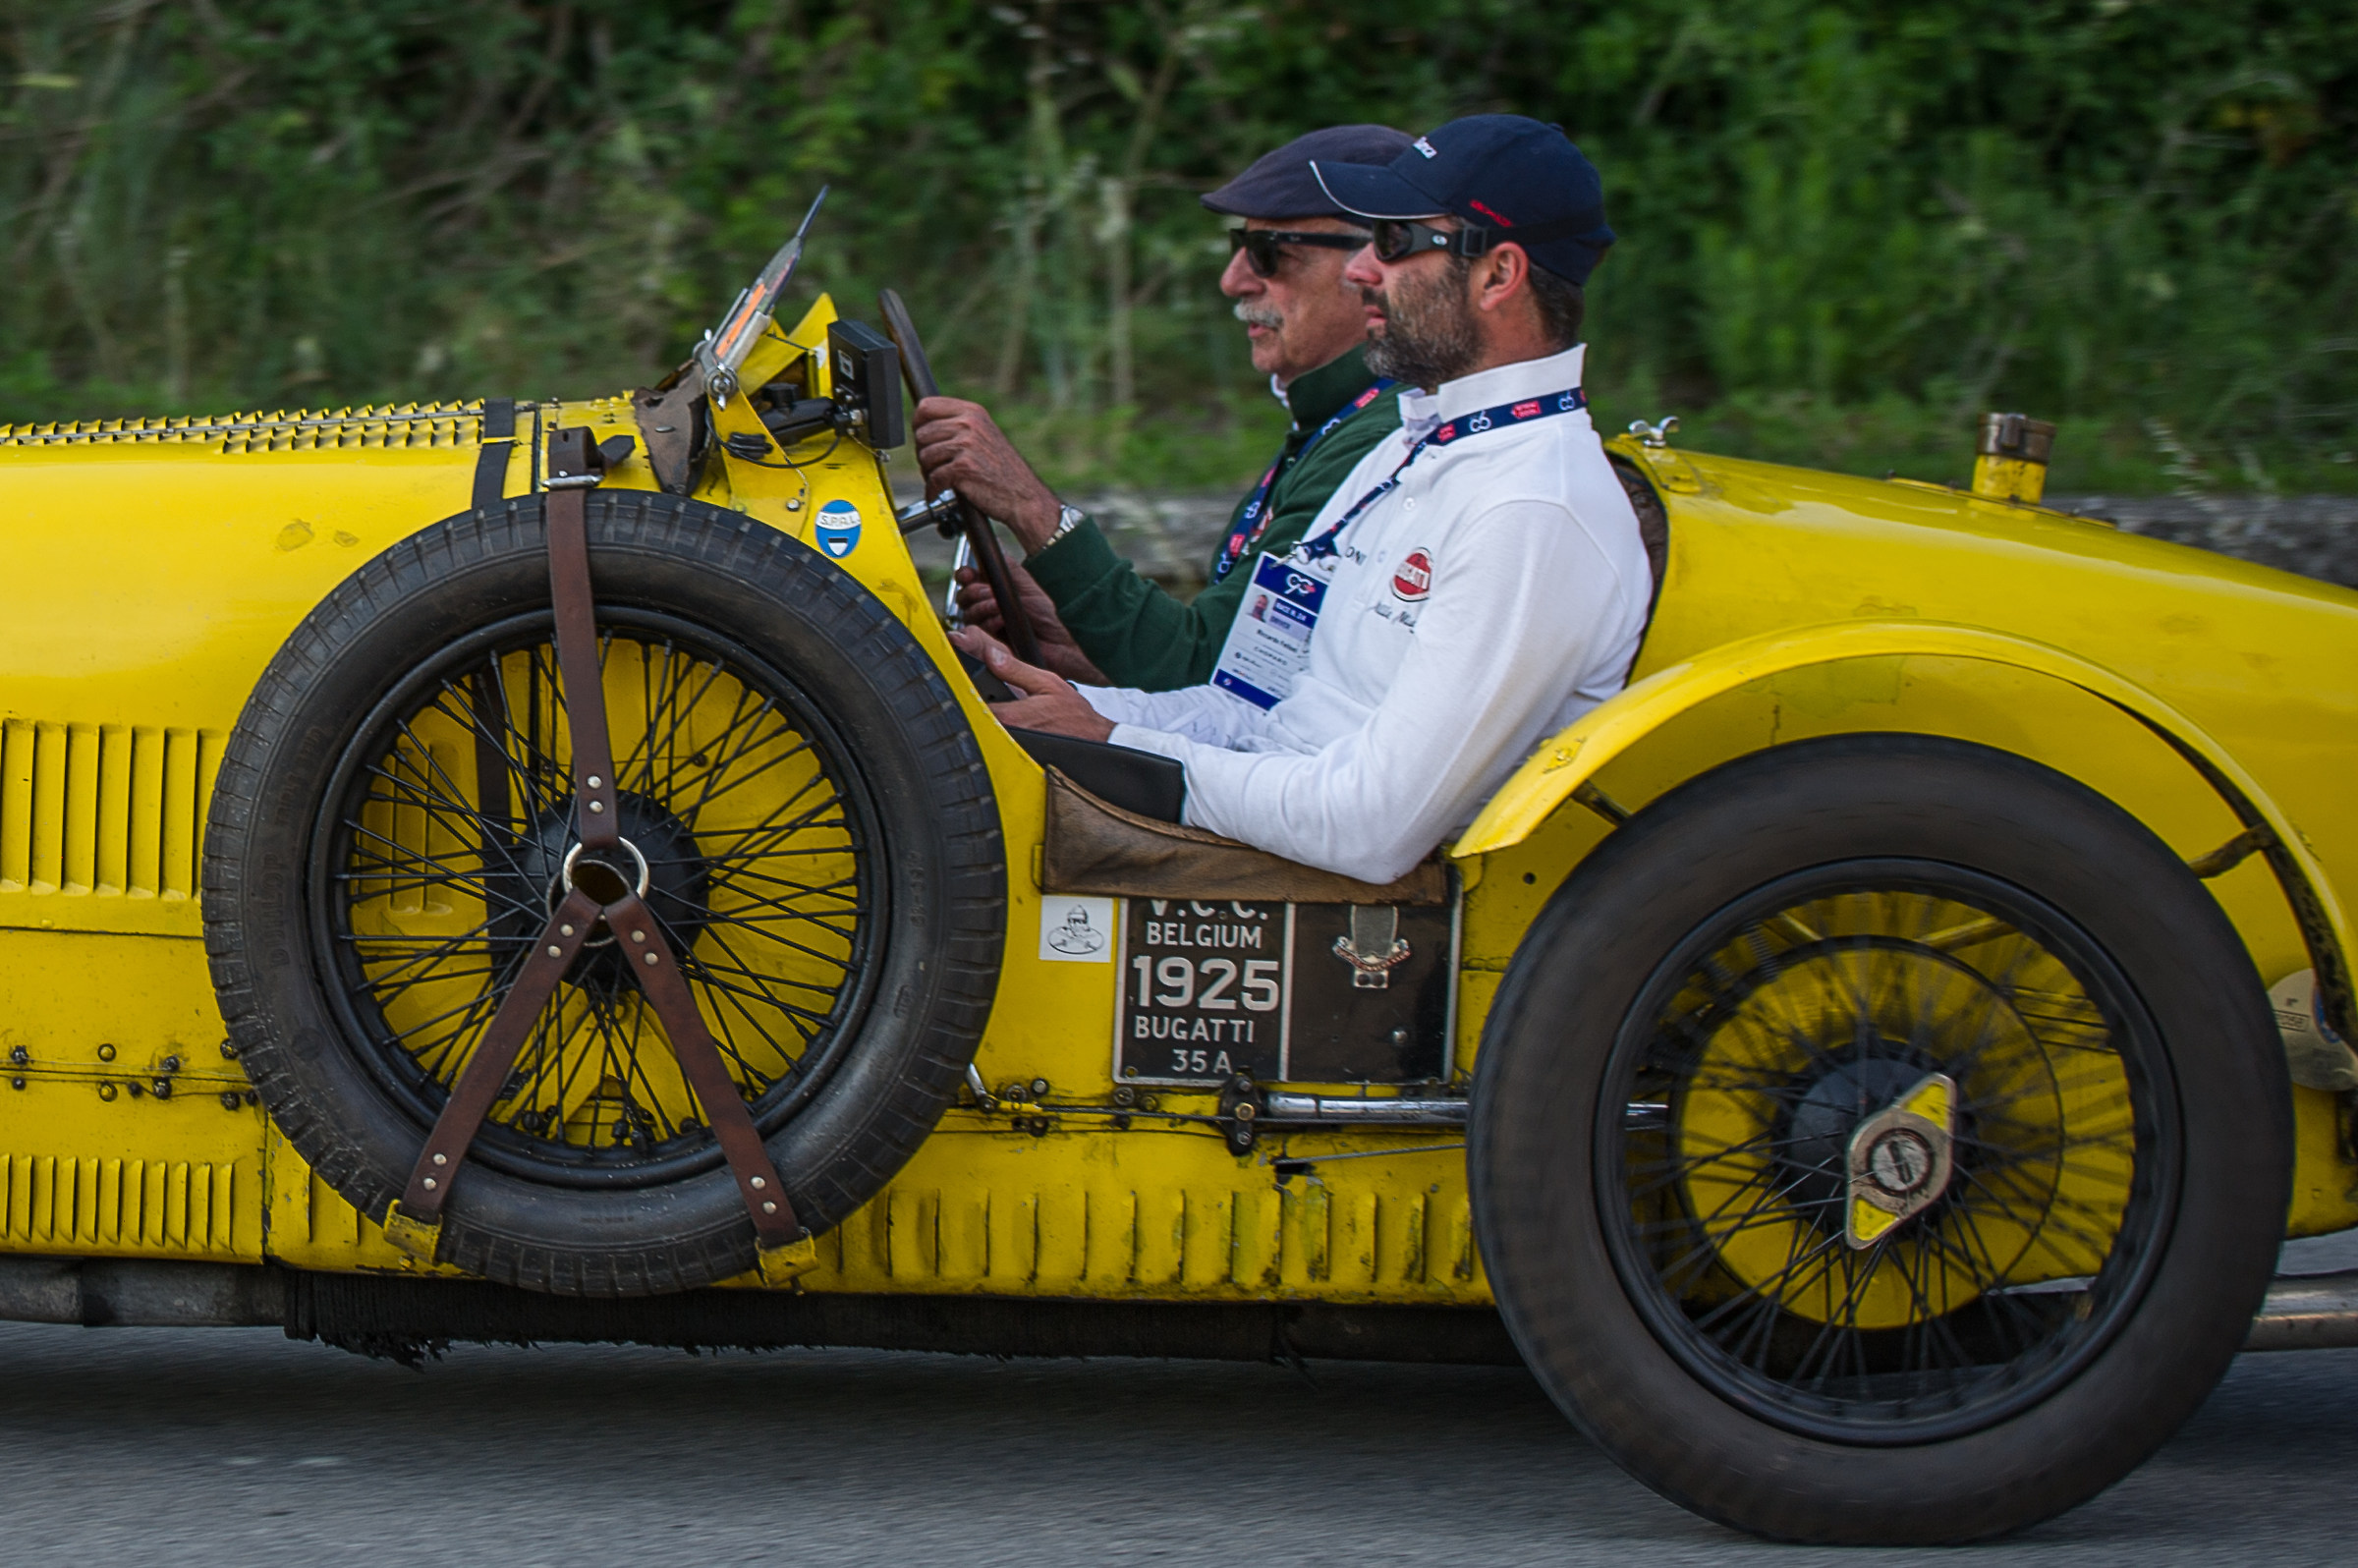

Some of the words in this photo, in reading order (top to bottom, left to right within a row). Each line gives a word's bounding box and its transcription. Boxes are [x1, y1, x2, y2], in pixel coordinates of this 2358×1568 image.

[1147, 922, 1263, 949] BELGIUM
[1133, 955, 1278, 1011] 1925
[1134, 1015, 1254, 1043] BUGATTI
